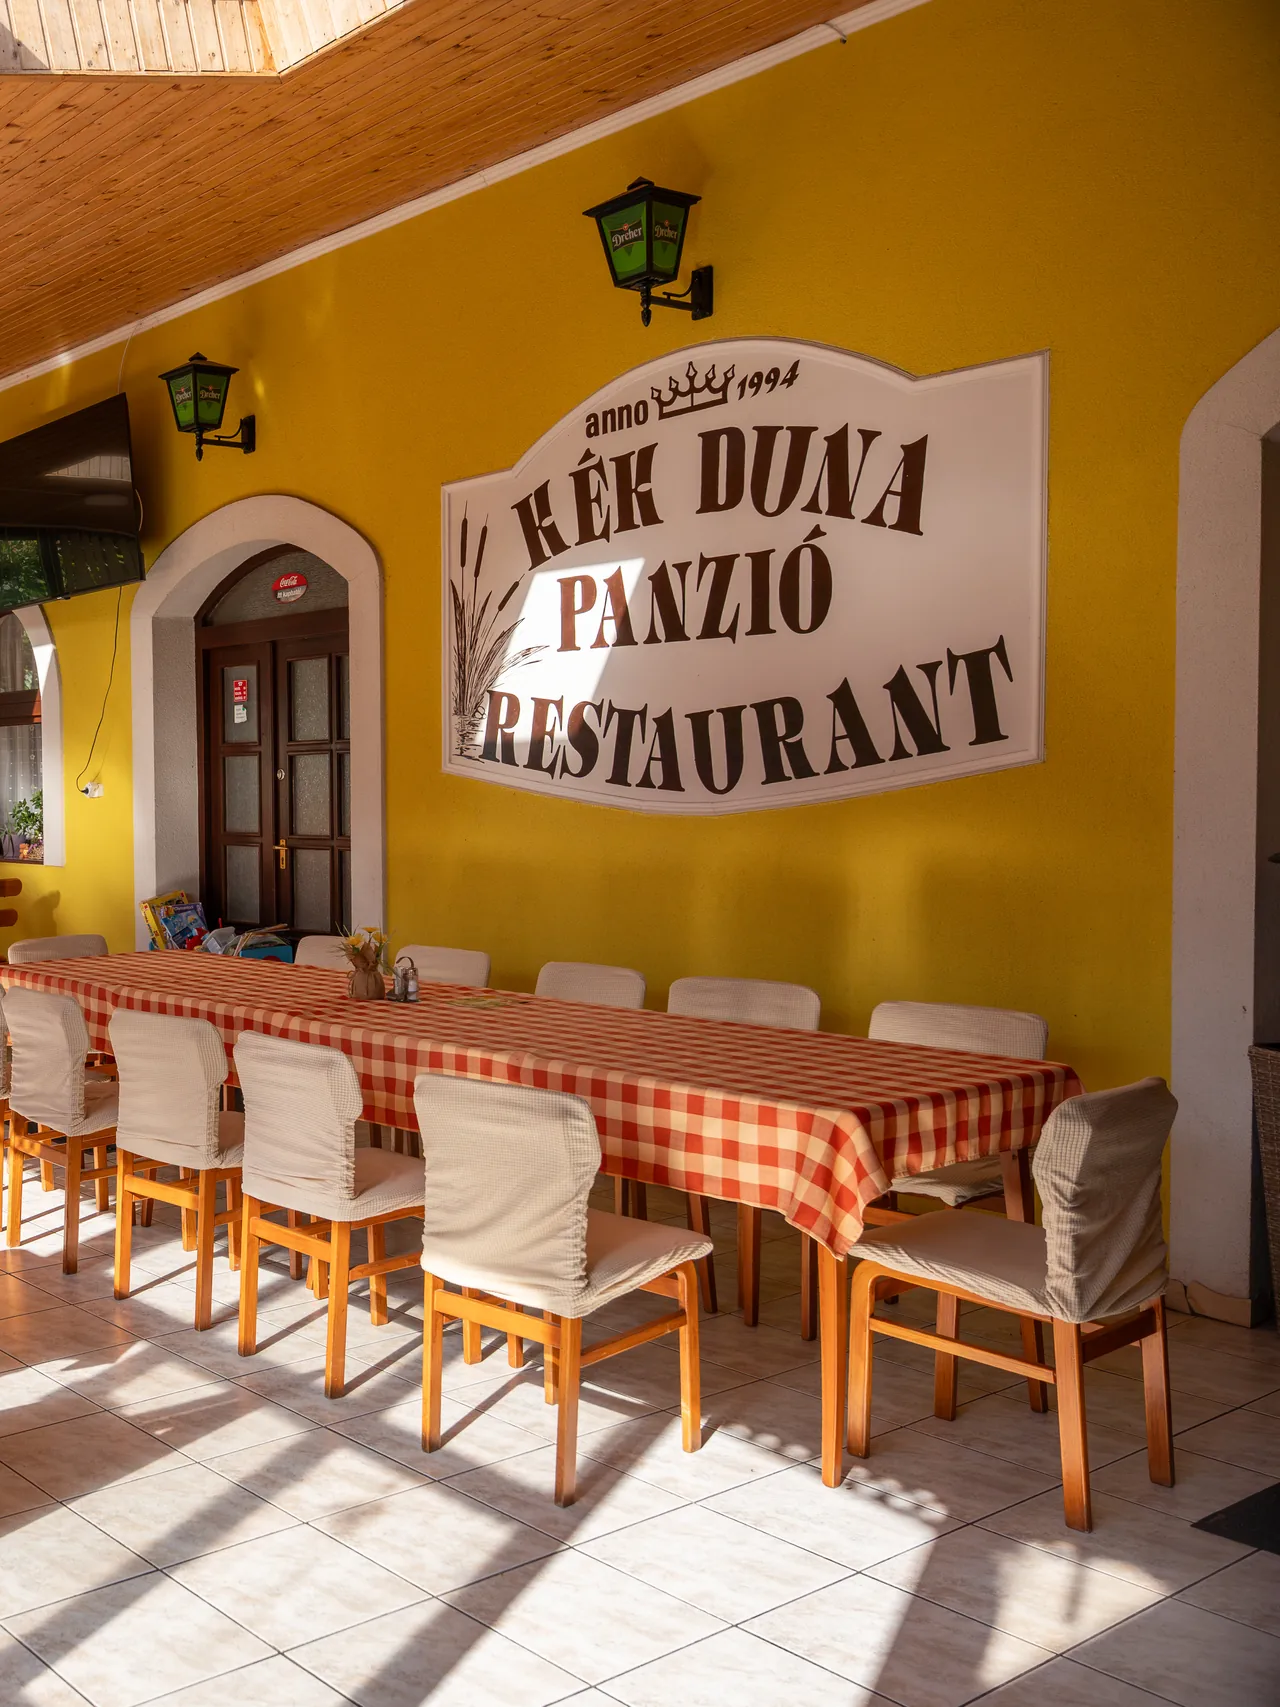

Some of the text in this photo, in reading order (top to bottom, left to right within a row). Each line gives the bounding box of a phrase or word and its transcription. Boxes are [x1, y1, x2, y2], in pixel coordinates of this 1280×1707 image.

[612, 227, 642, 247] Dreher
[654, 225, 677, 239] Dreher
[585, 359, 801, 439] anno 1994
[510, 422, 929, 571] KÉK DUNA
[556, 524, 834, 653] PANZIÓ
[478, 634, 1014, 796] RESTAURANT
